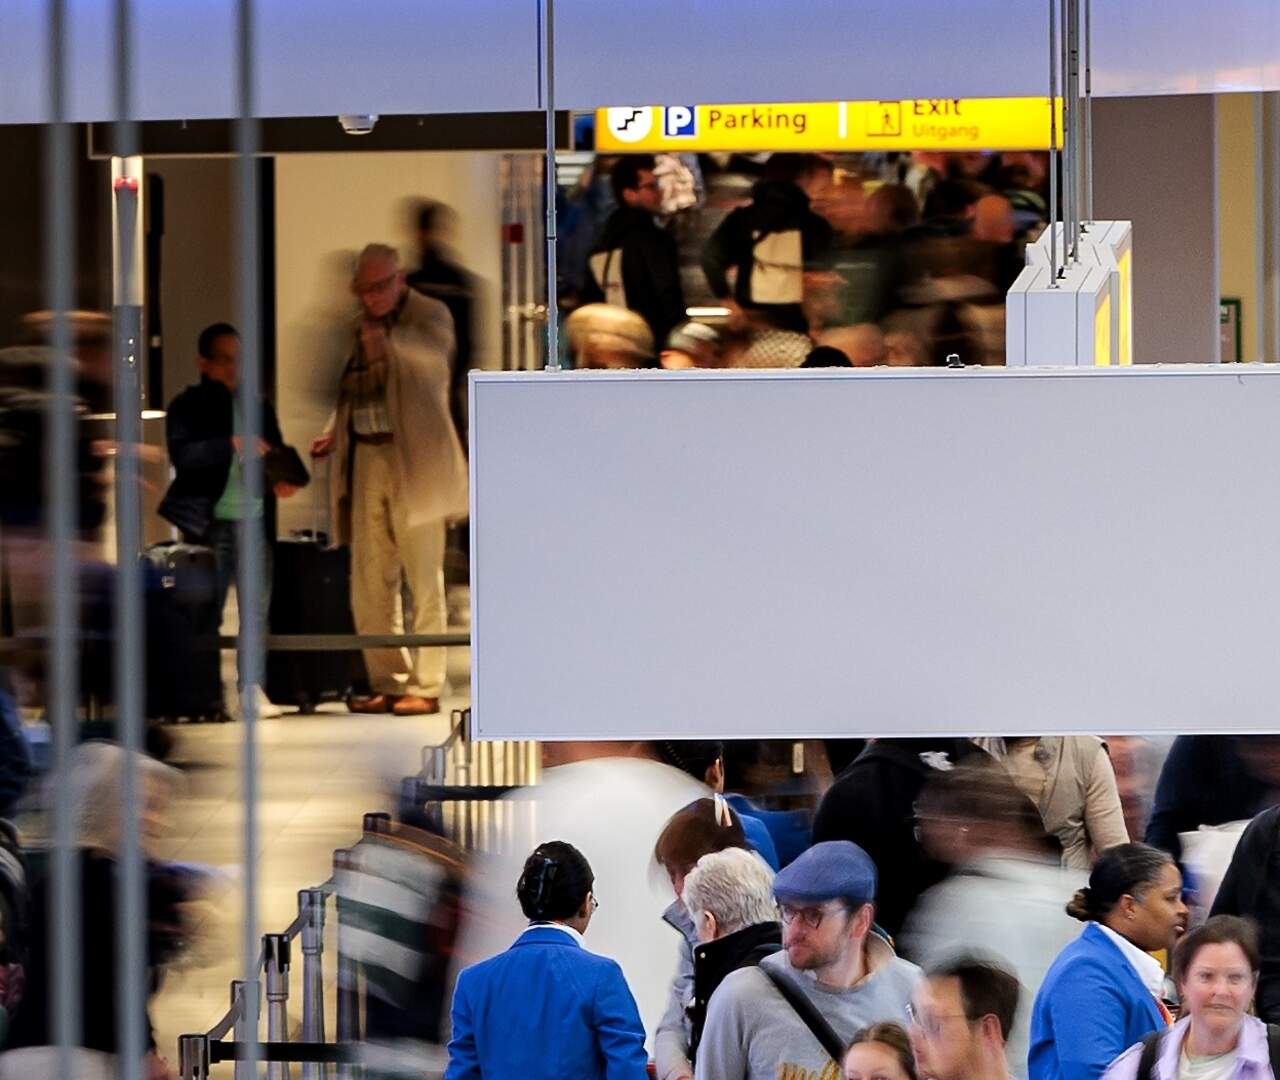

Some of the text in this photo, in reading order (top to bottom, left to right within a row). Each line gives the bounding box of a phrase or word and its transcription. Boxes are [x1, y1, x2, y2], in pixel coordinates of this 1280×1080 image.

[912, 99, 962, 117] Exit
[708, 109, 807, 134] Parking
[912, 123, 980, 140] Uitgang
